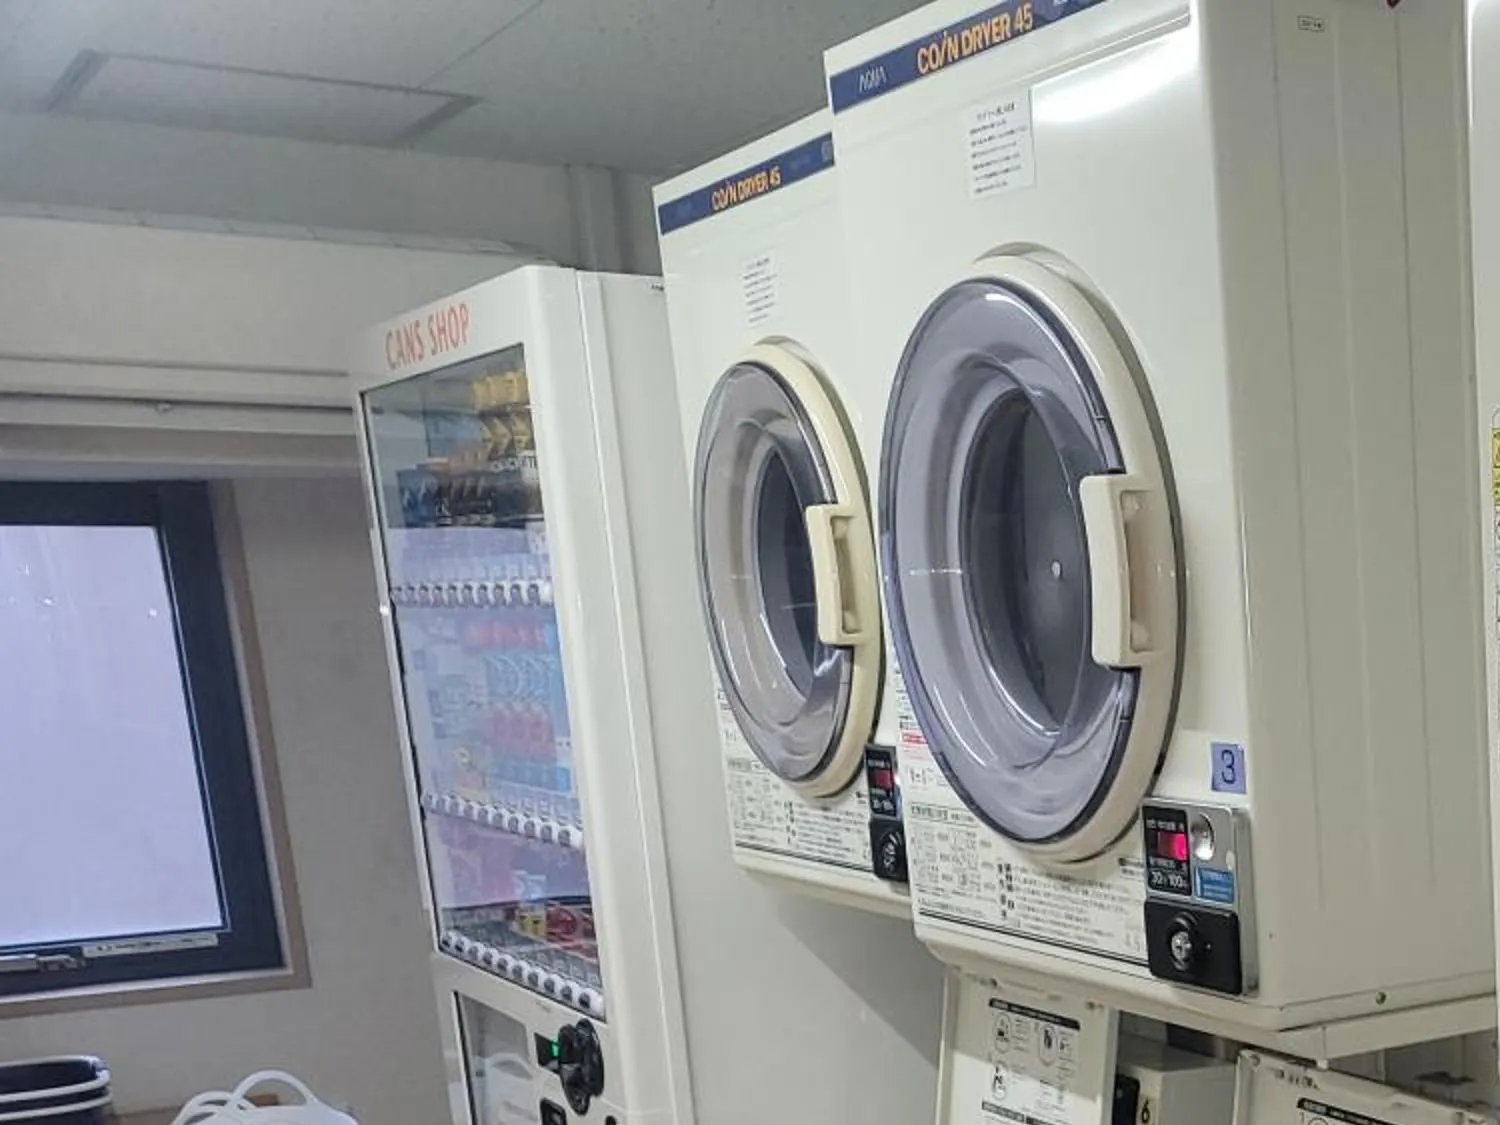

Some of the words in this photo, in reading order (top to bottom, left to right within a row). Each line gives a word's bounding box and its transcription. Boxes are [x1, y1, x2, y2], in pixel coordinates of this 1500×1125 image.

[960, 12, 1012, 55] DRYER
[1013, 3, 1034, 35] 45
[737, 170, 769, 201] DRYER
[769, 164, 782, 188] 45
[385, 319, 425, 370] CANS
[428, 303, 469, 356] SHOP
[1221, 749, 1236, 784] 3
[1141, 1096, 1151, 1125] 6
